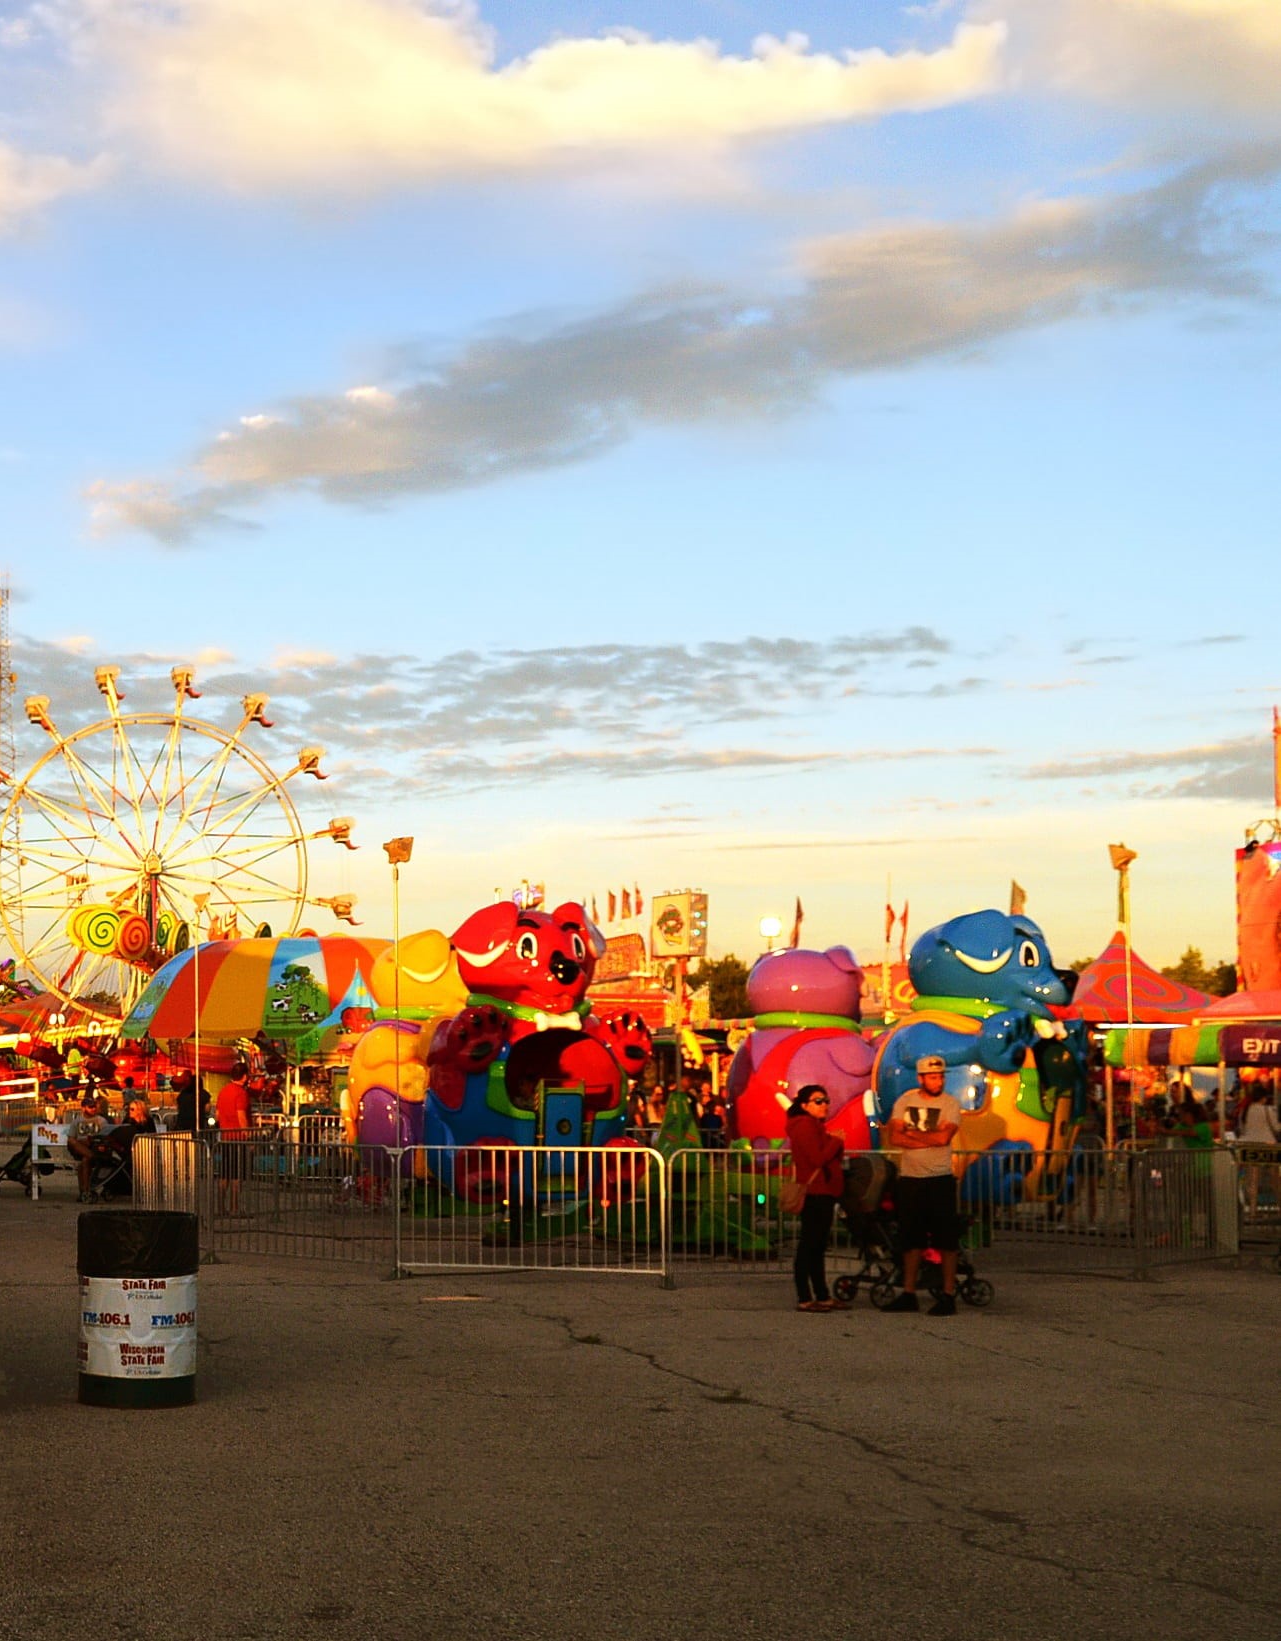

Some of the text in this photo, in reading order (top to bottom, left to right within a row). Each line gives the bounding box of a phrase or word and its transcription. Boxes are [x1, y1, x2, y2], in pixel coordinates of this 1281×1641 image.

[122, 1280, 166, 1291] STATE FAIR
[120, 1343, 165, 1355] WISCONSIN
[121, 1355, 165, 1366] STATE FAIR
